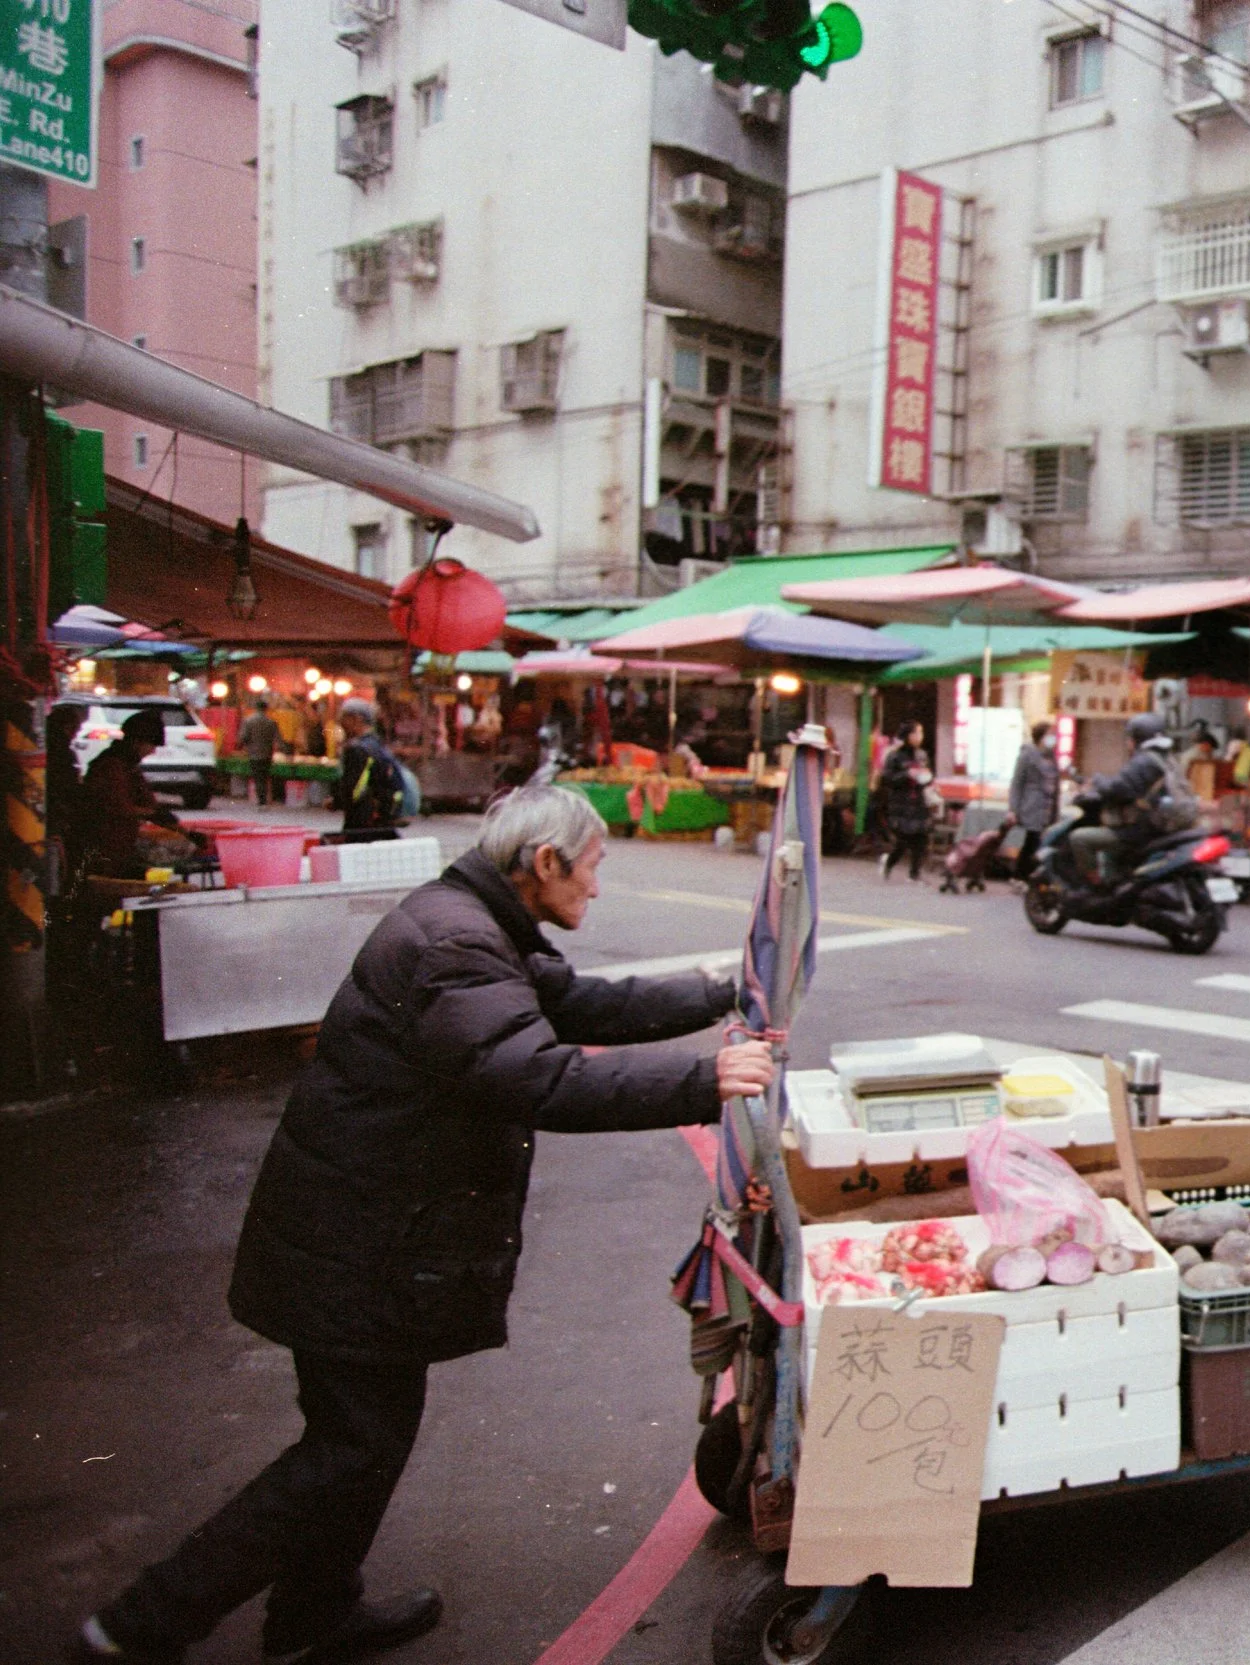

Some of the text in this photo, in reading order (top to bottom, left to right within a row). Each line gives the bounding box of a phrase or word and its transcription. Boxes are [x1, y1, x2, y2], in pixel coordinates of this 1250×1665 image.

[19, 21, 70, 76] 巷
[0, 66, 73, 113] MinZu
[29, 108, 71, 144] Rd.
[829, 1319, 976, 1383] 蒜頭
